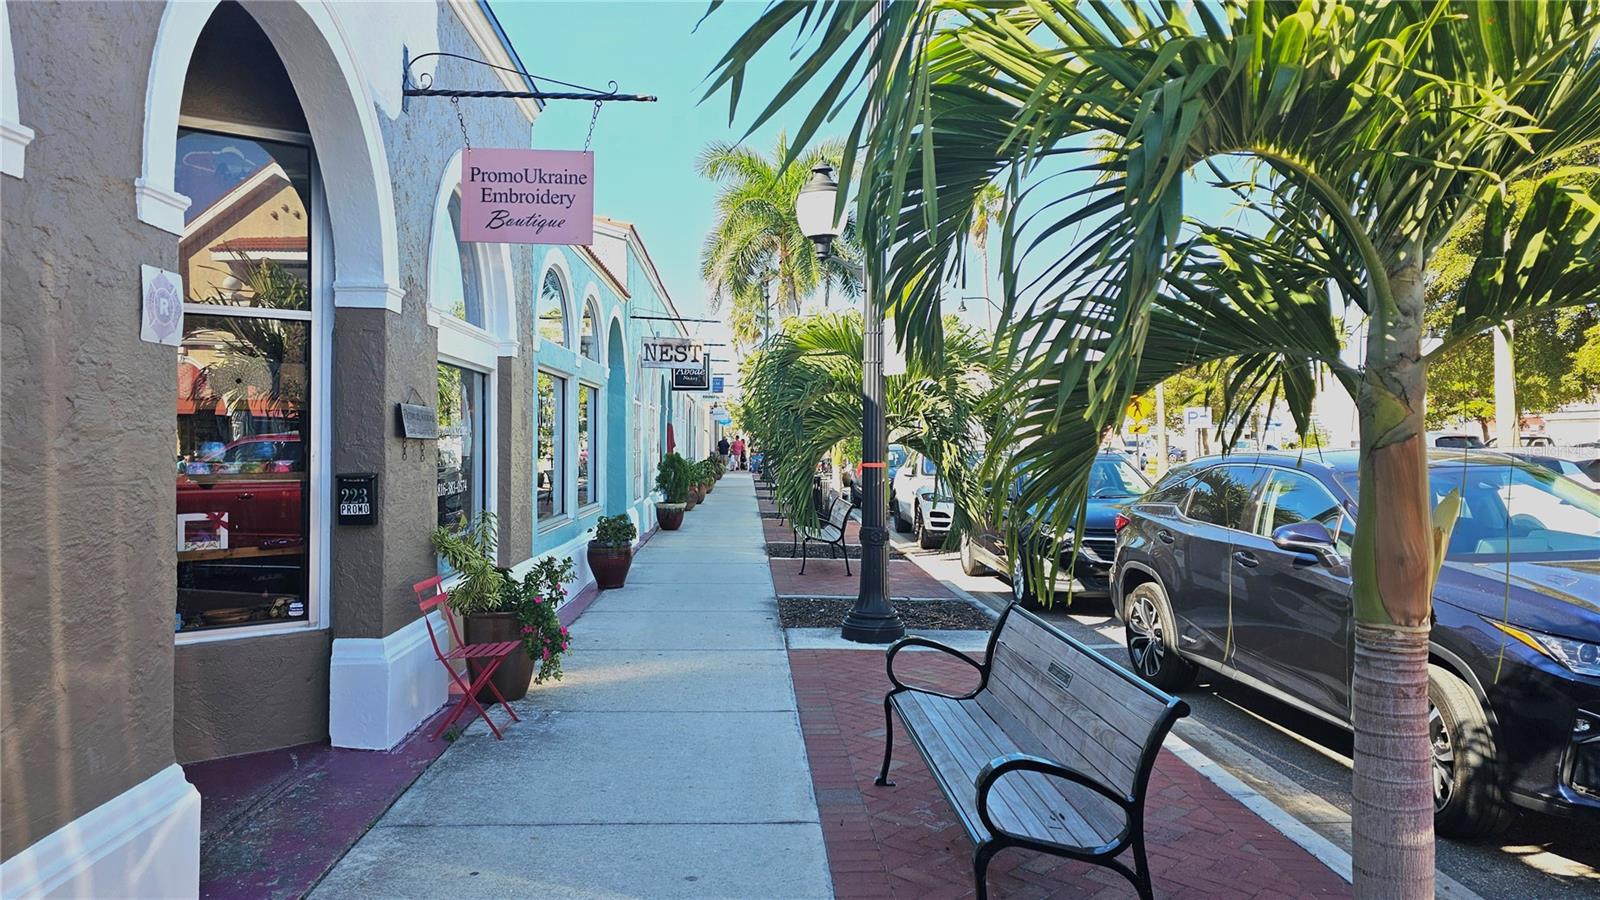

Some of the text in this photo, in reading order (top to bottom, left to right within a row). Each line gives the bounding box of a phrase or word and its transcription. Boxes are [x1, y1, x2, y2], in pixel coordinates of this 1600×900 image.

[470, 167, 588, 185] PromoUkraine
[480, 187, 576, 209] Embroidery
[485, 209, 566, 235] Boutique
[160, 297, 169, 316] R
[643, 343, 702, 363] NEST
[1187, 411, 1199, 425] P
[341, 488, 368, 504] 223
[341, 504, 369, 514] PROMO
